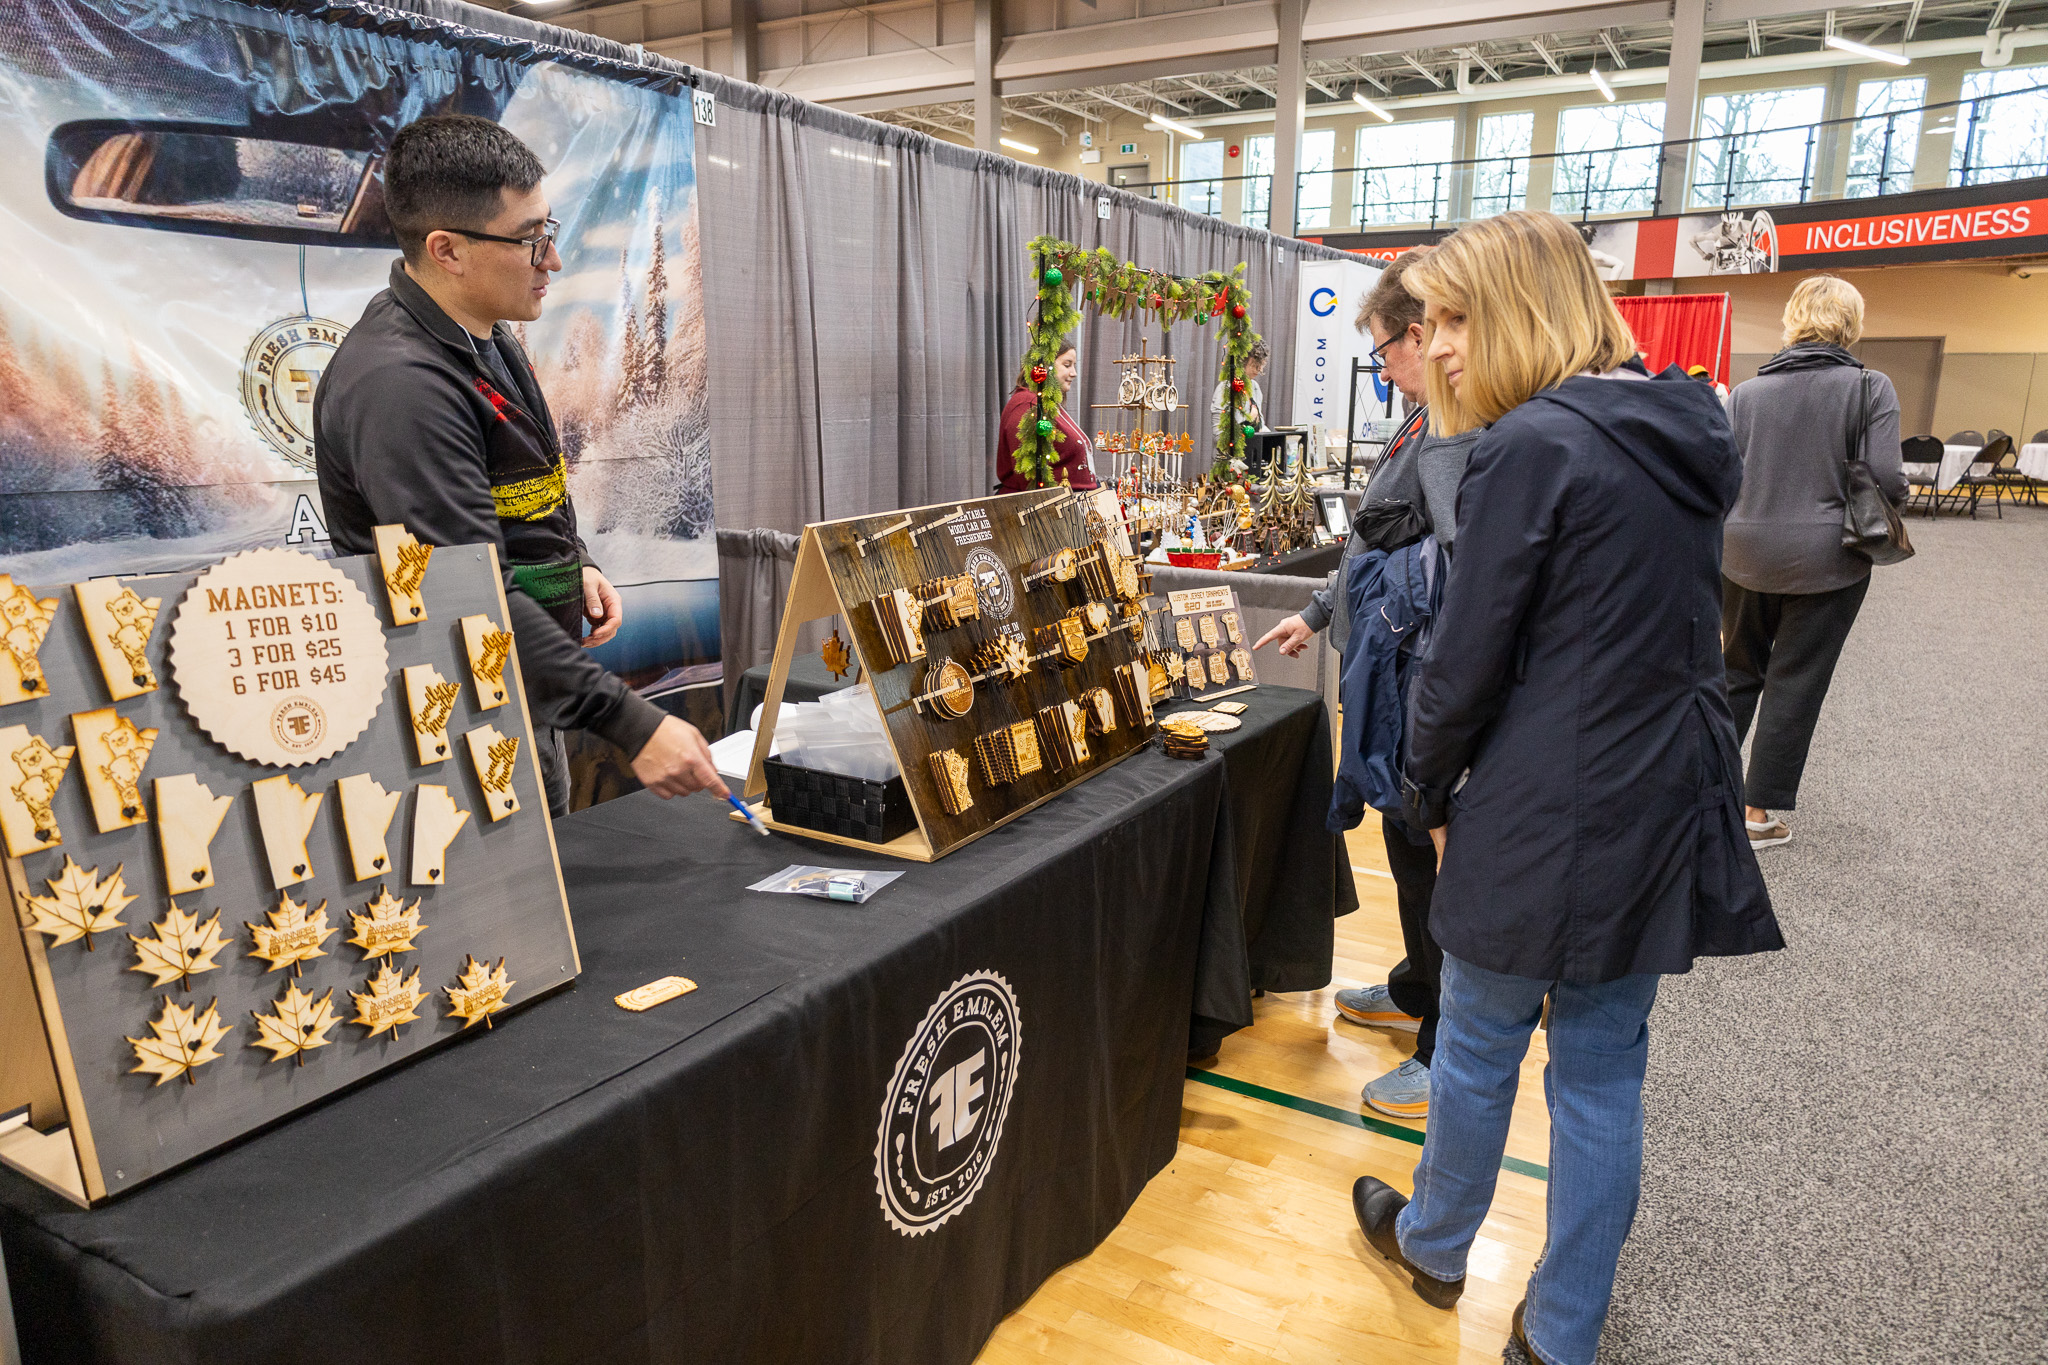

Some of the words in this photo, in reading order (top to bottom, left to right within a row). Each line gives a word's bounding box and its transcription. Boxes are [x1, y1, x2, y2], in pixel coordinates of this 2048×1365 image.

[695, 96, 713, 124] 138
[1805, 206, 2031, 250] INCLUSIVENESS
[257, 328, 302, 376] FRESH
[947, 523, 966, 535] WOOD
[966, 521, 979, 531] CAR
[980, 519, 991, 529] AIR
[954, 531, 993, 546] FRESHENERS
[385, 544, 417, 595] Friendly
[400, 543, 434, 599] Manitoba
[206, 581, 344, 613] MAGNETS:
[1184, 602, 1200, 612] $20
[225, 620, 236, 640] 1
[247, 616, 291, 638] FOR
[301, 612, 338, 632] $10
[228, 648, 242, 668] 3
[252, 642, 296, 665] FOR
[305, 638, 342, 659] $25
[472, 632, 499, 682] Friendly
[484, 631, 513, 684] Manitoba
[232, 675, 247, 695] 6
[257, 669, 300, 692] FOR
[310, 663, 346, 685] $45
[412, 683, 442, 735] Friendly
[425, 682, 460, 738] Manitoba
[480, 741, 502, 793] Friendly
[493, 737, 518, 794] Manitoba
[898, 1015, 947, 1115] FRESH
[953, 995, 1009, 1048] EMBLEM
[924, 1184, 954, 1209] EST.
[958, 1150, 983, 1189] 2016
